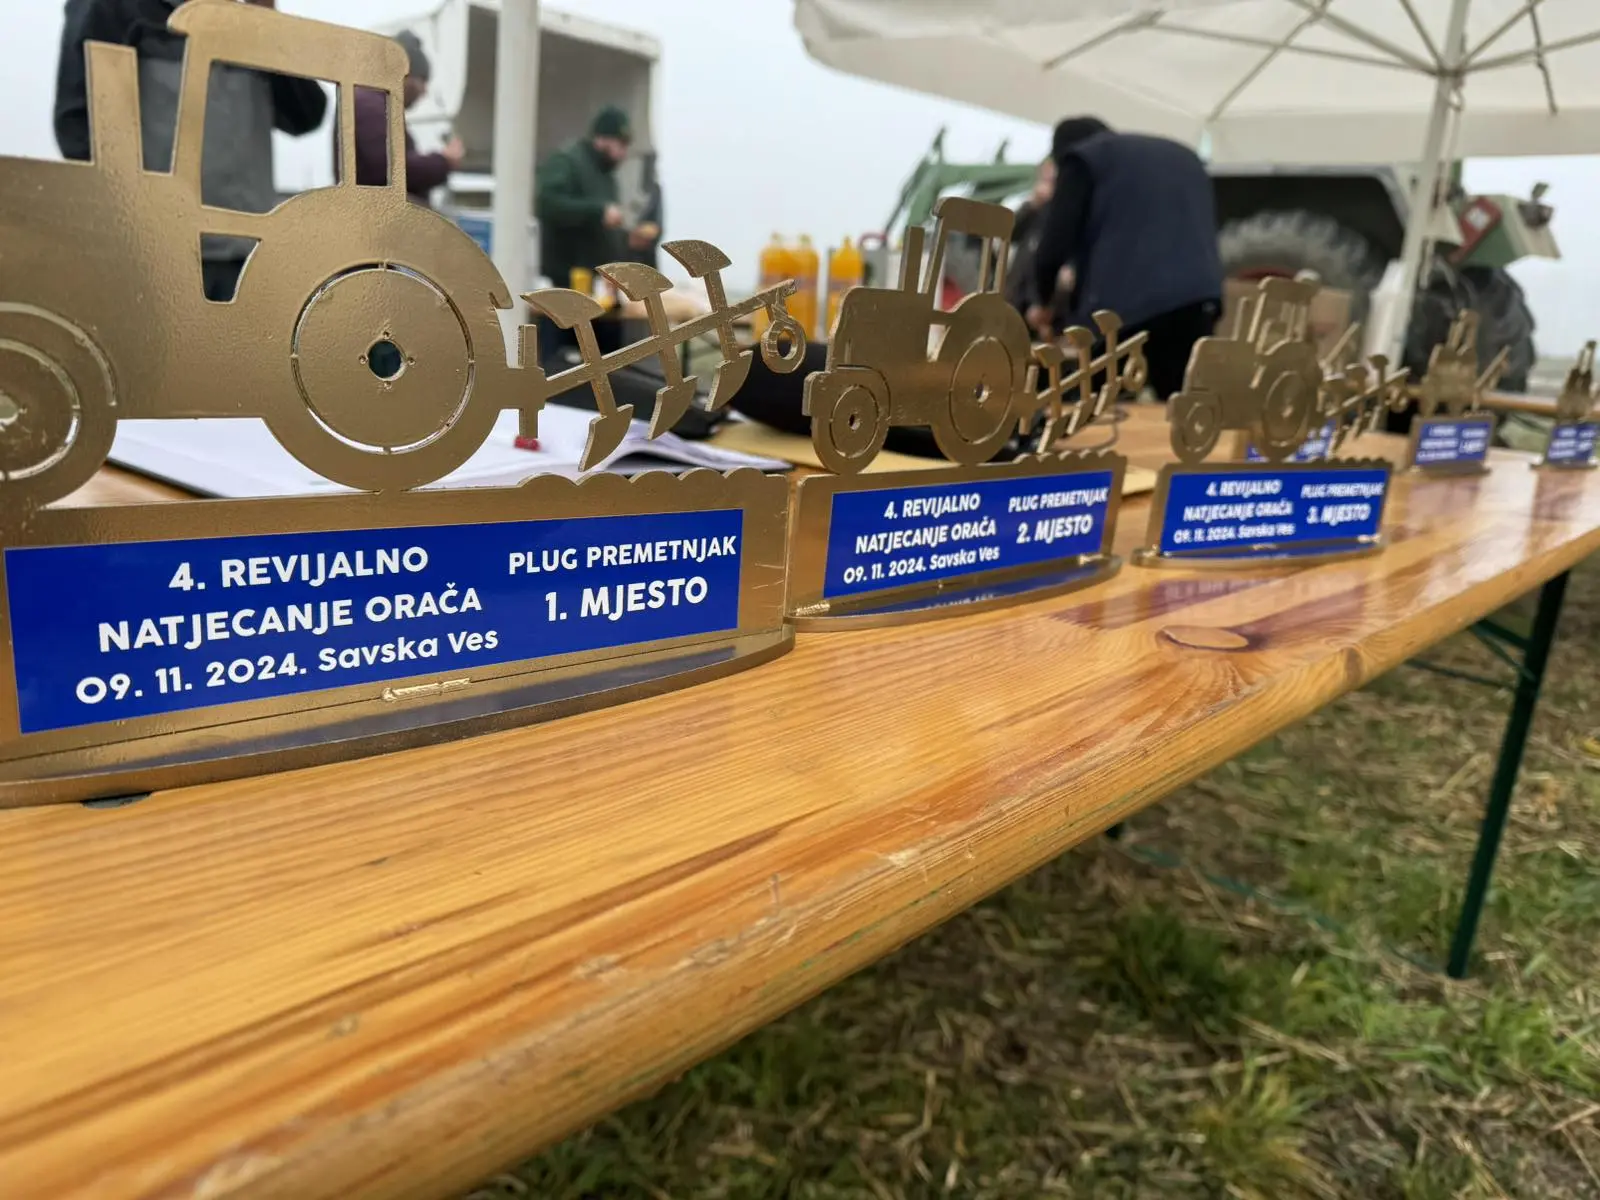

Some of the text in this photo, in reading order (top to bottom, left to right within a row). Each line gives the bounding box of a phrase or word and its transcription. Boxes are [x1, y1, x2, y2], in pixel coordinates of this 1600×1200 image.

[884, 493, 980, 519] 4. REVIJALNO
[1008, 495, 1038, 512] PLUG
[856, 516, 996, 554] NATJECANJE ORAČA
[1017, 514, 1093, 543] 2. MJESTO
[169, 547, 428, 590] 4. REVIJALNO
[510, 536, 736, 574] PLUG PREMETNJAK
[844, 547, 999, 583] 09. 11. 2024. Savska Ves
[99, 583, 482, 653] NATJECANJE ORAČA
[546, 577, 707, 621] 1. MJESTO
[76, 631, 498, 704] 09. 11. 2024. Savska Ves
